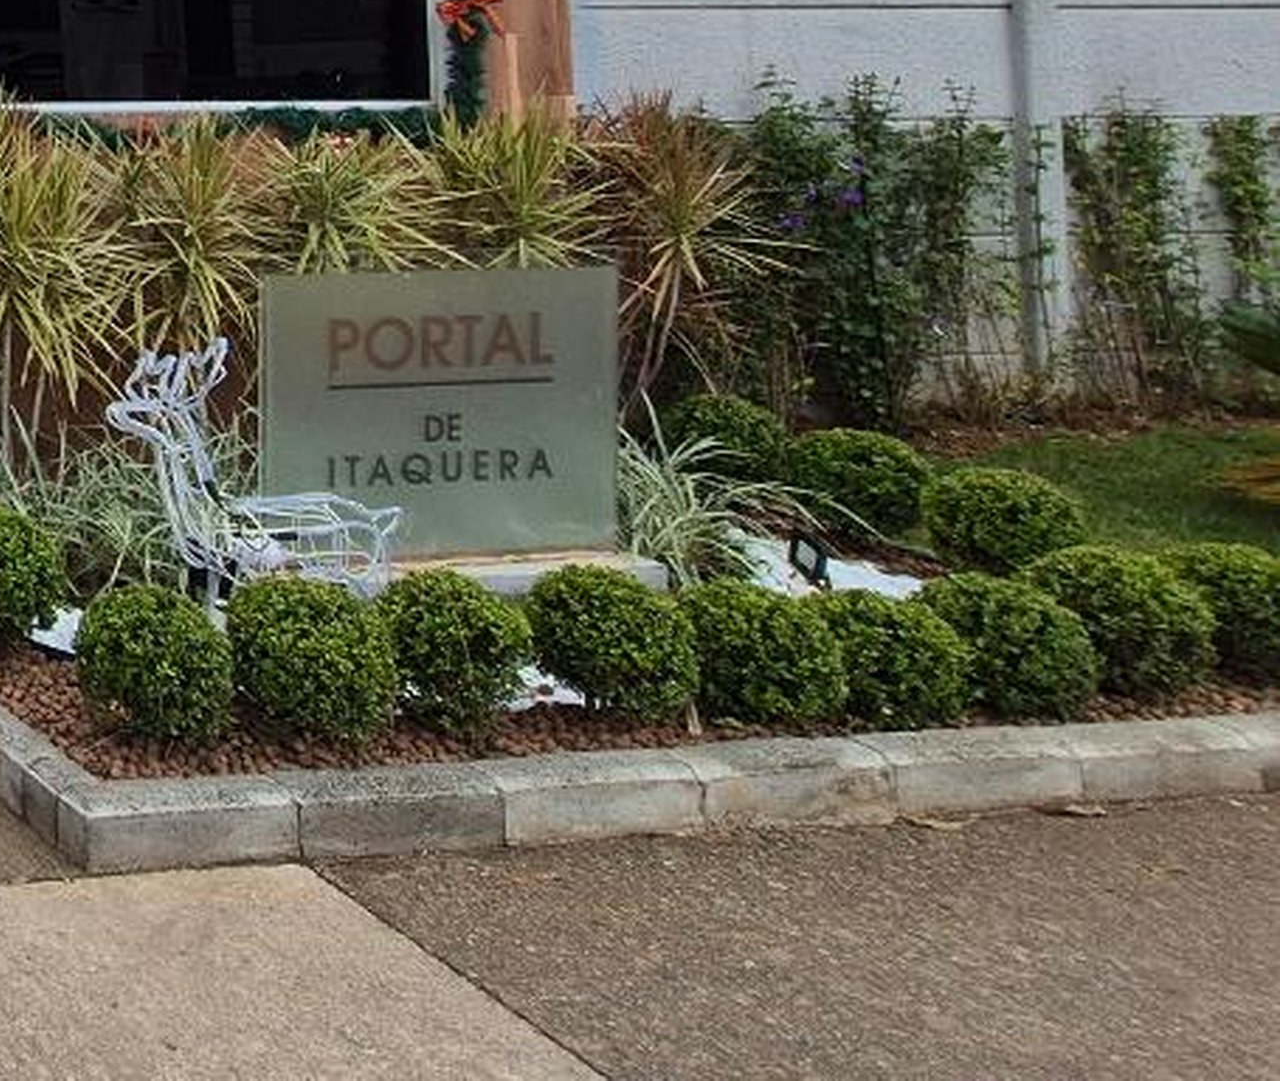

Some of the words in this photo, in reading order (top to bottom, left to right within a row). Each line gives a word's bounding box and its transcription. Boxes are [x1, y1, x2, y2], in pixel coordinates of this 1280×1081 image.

[326, 312, 555, 371] PORTAL
[423, 413, 463, 443] DE
[326, 448, 555, 488] ITAQUERA
